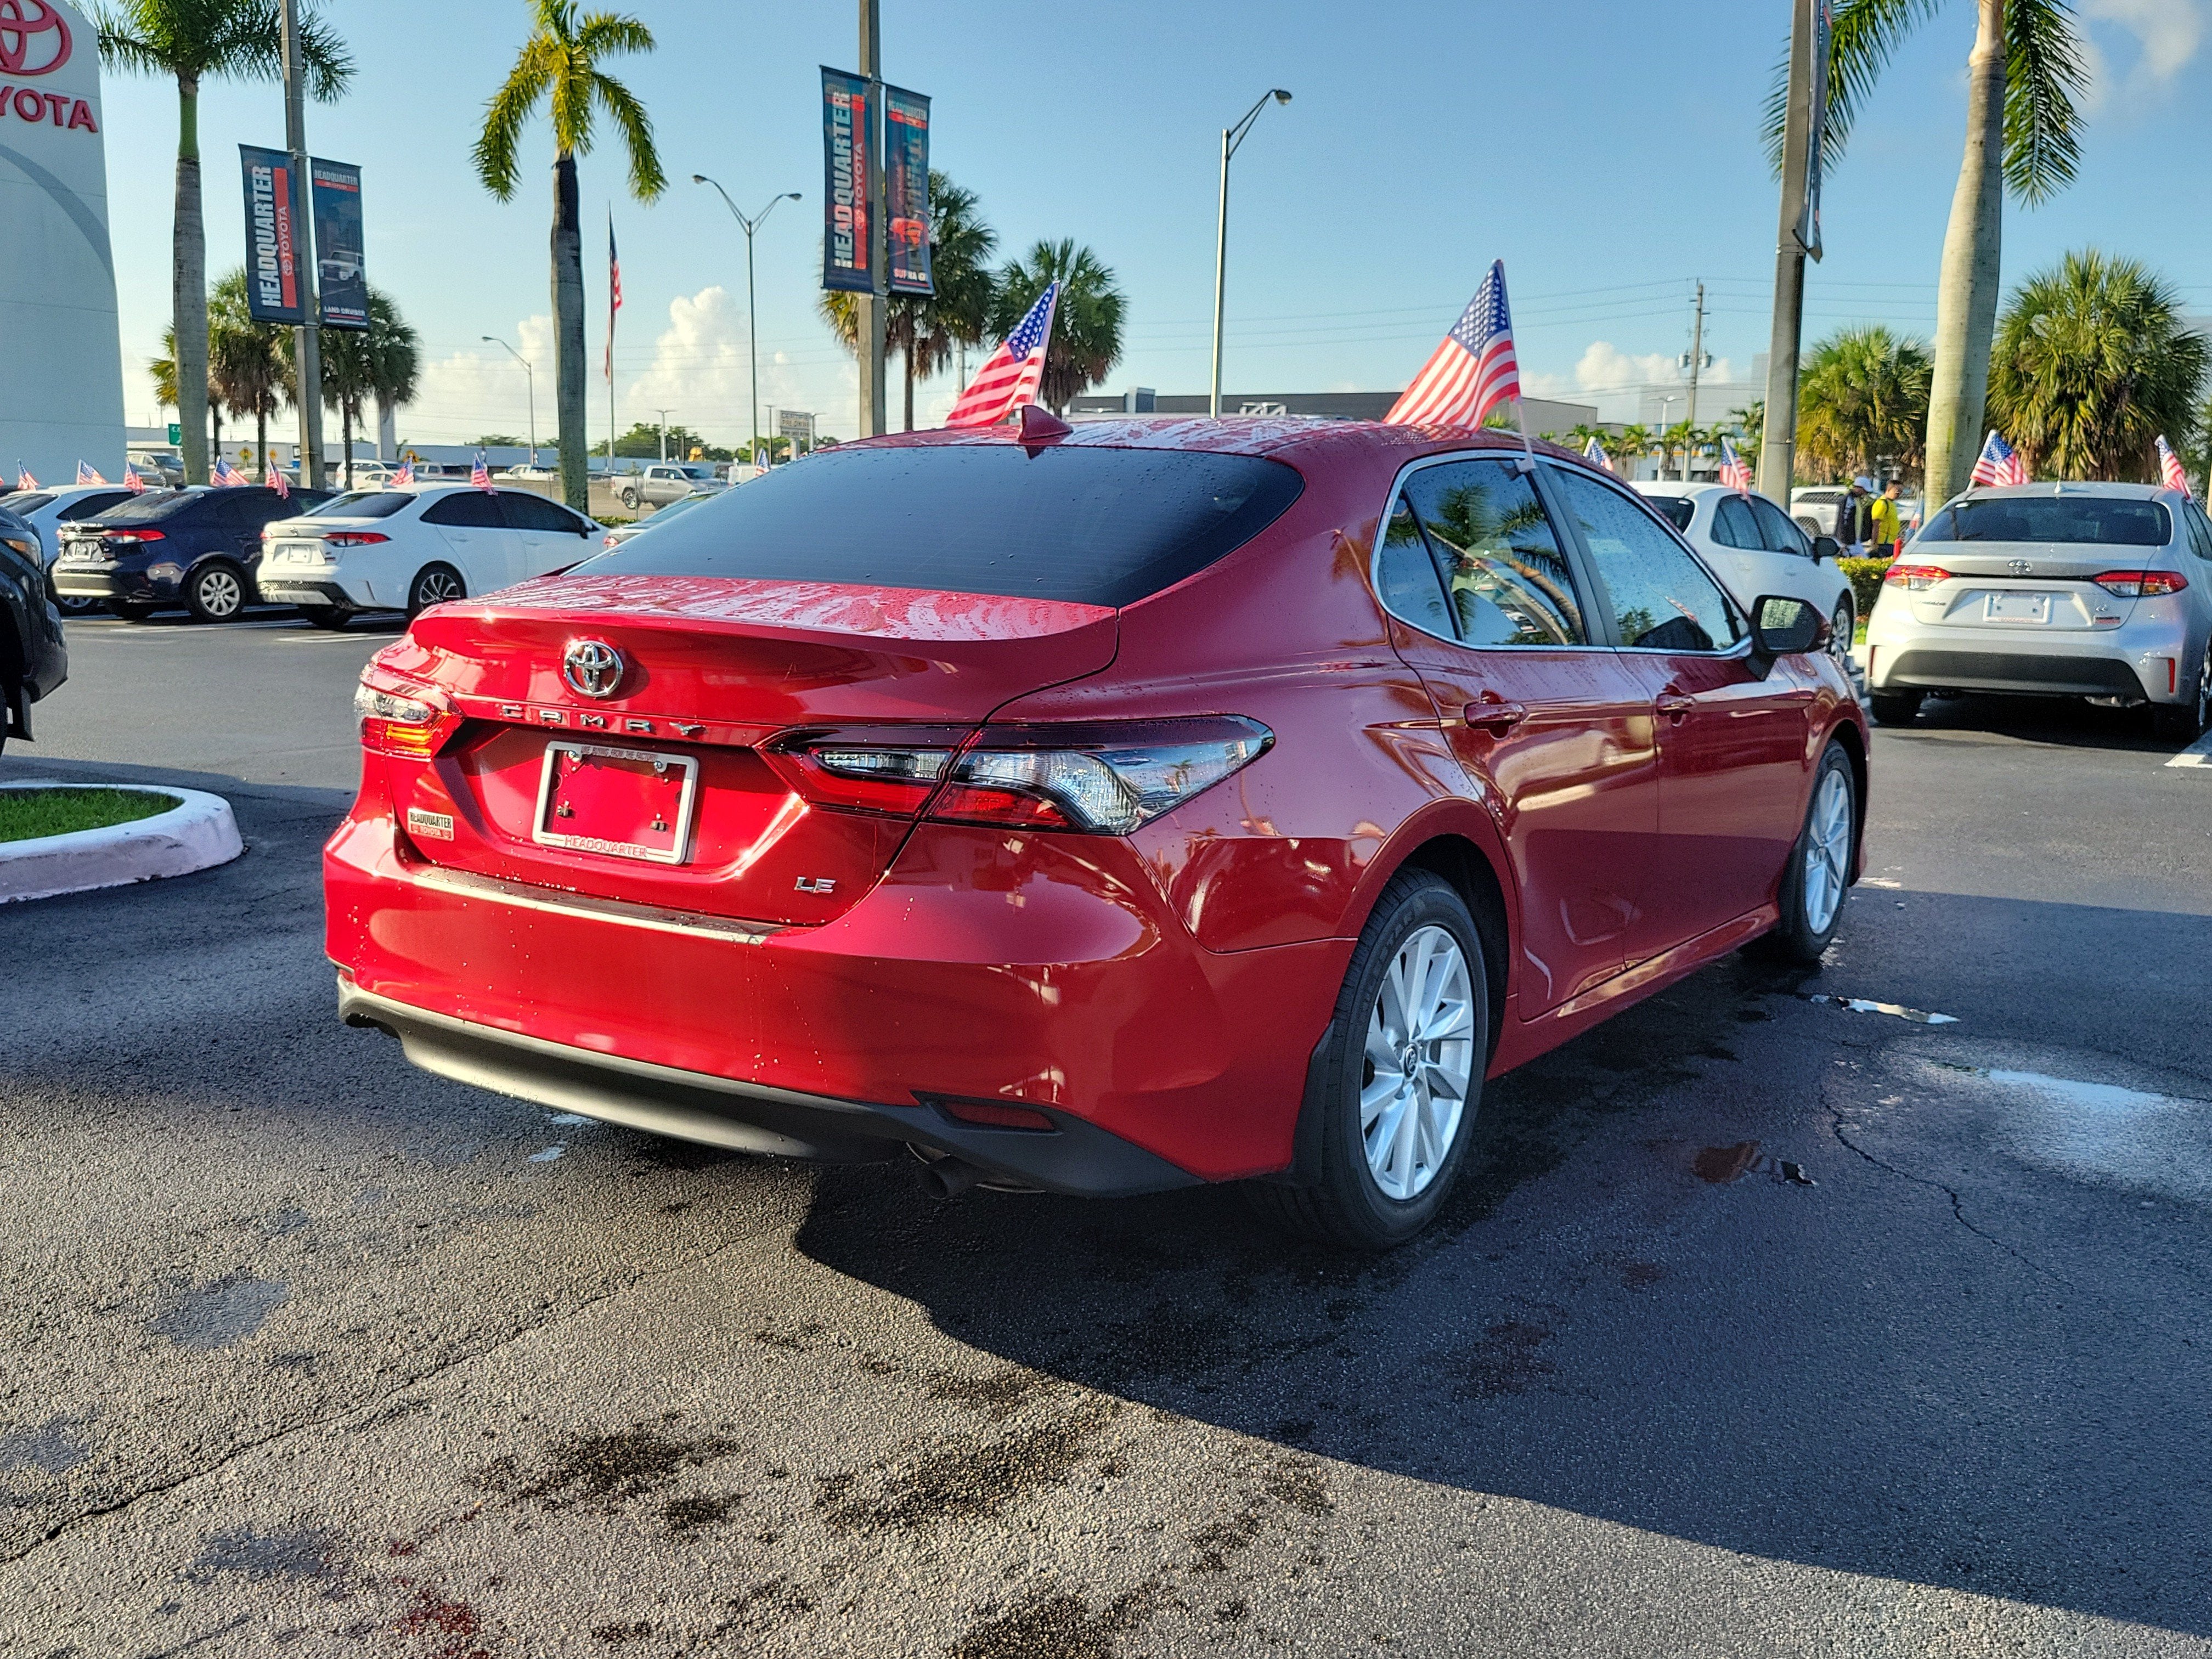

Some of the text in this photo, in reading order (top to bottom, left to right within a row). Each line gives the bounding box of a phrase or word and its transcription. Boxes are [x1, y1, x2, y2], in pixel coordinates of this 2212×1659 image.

[314, 169, 358, 186] HEADQUARTER
[833, 91, 854, 269] HEADQUARTER
[854, 143, 864, 208] TOYOTA
[252, 166, 282, 307] HEADQUARTER
[279, 206, 290, 257] TOYOTA
[501, 704, 706, 736] CAMRY
[410, 812, 452, 829] HEADQUARTER
[420, 826, 443, 837] TOYOTA
[565, 834, 647, 858] HEADQUARTER
[794, 876, 837, 894] LE
